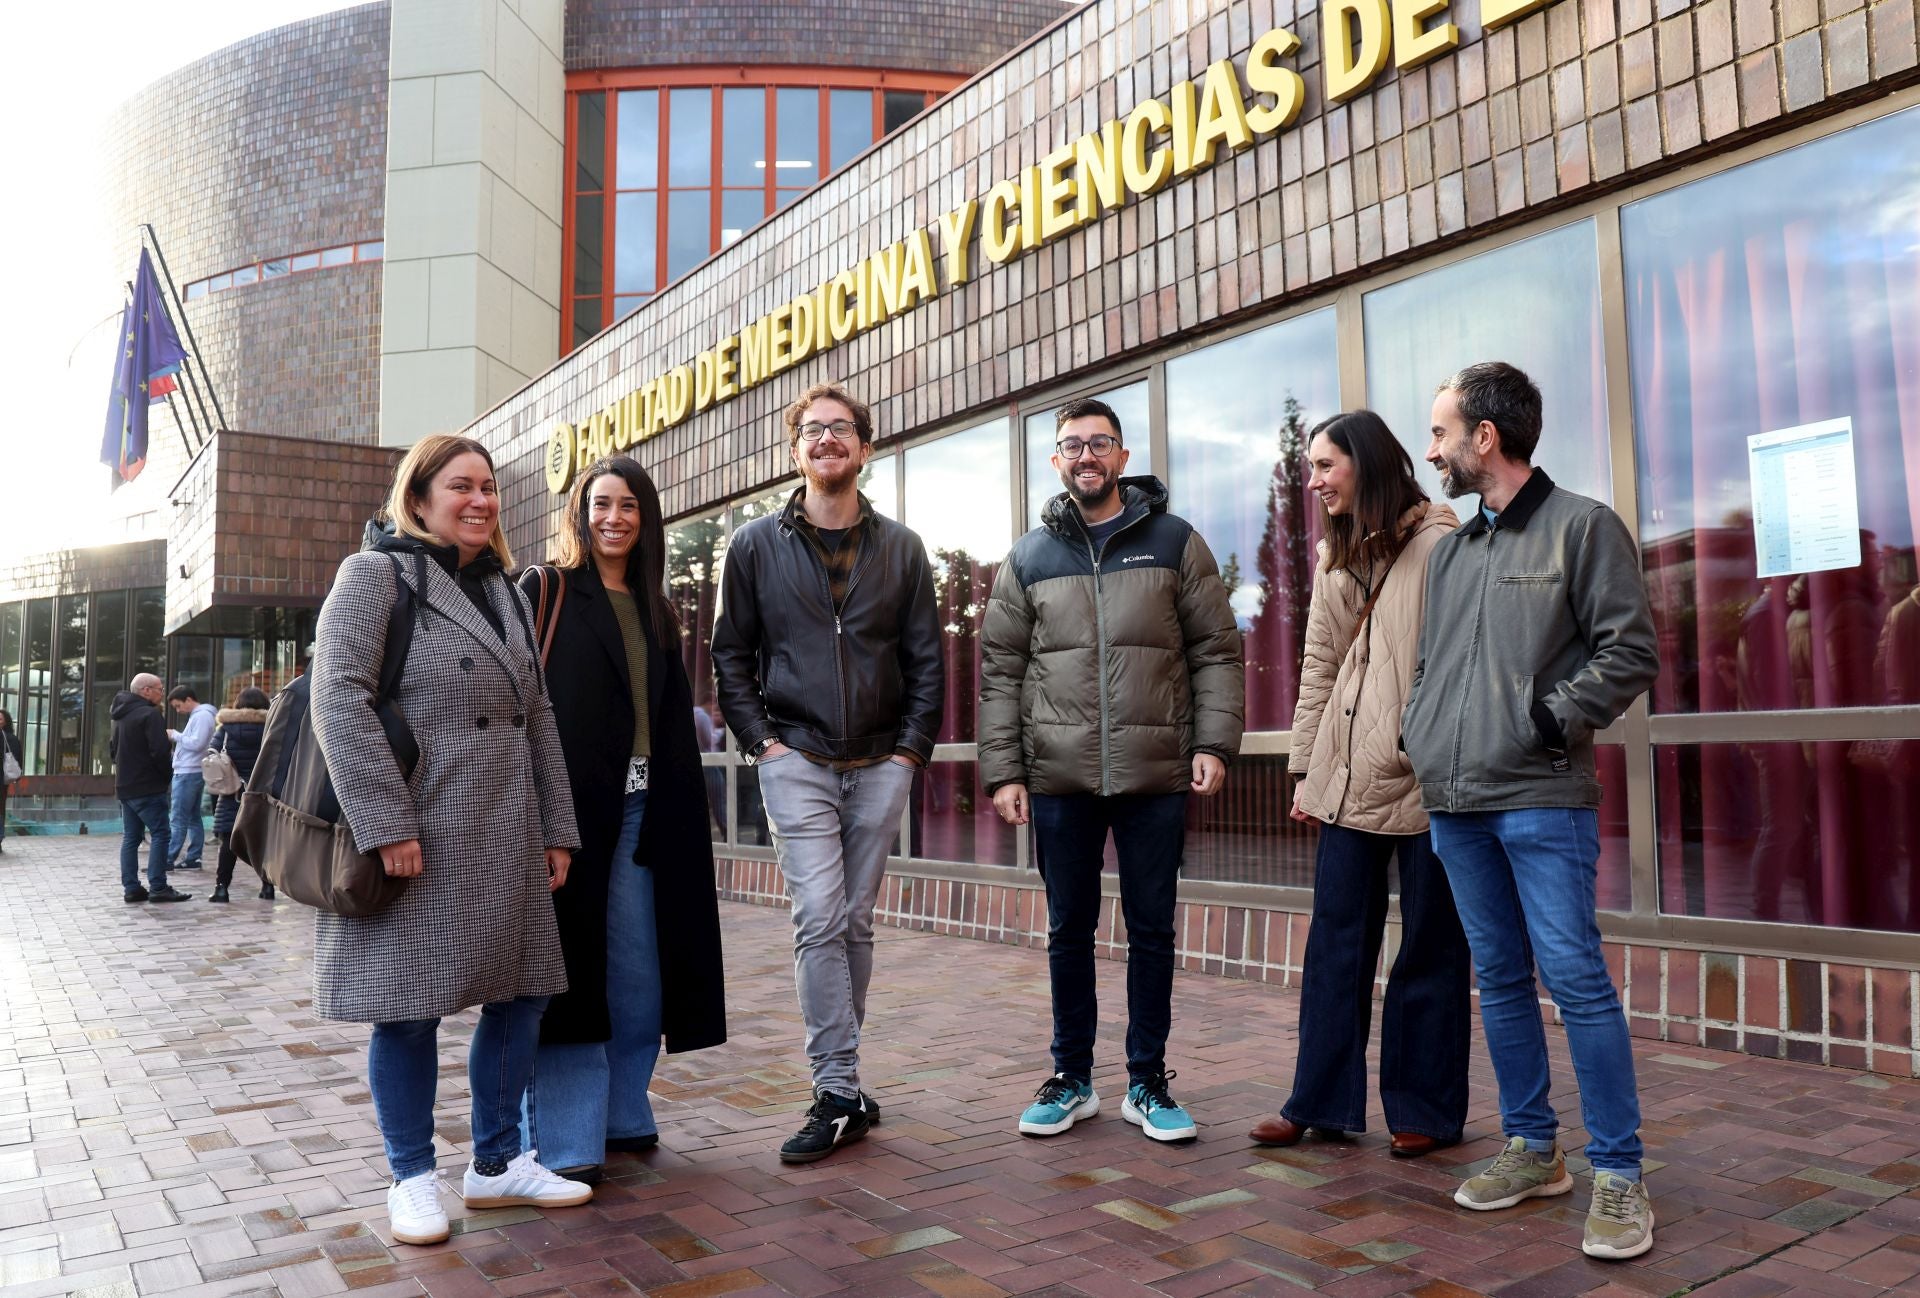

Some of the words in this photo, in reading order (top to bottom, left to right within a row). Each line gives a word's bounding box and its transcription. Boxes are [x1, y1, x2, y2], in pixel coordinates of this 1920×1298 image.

[576, 367, 694, 470] FACULTAD
[695, 336, 739, 411] DE
[741, 229, 938, 389] MEDICINA
[939, 199, 977, 286] Y
[983, 28, 1304, 264] CIENCIAS
[1128, 554, 1155, 562] Columbia
